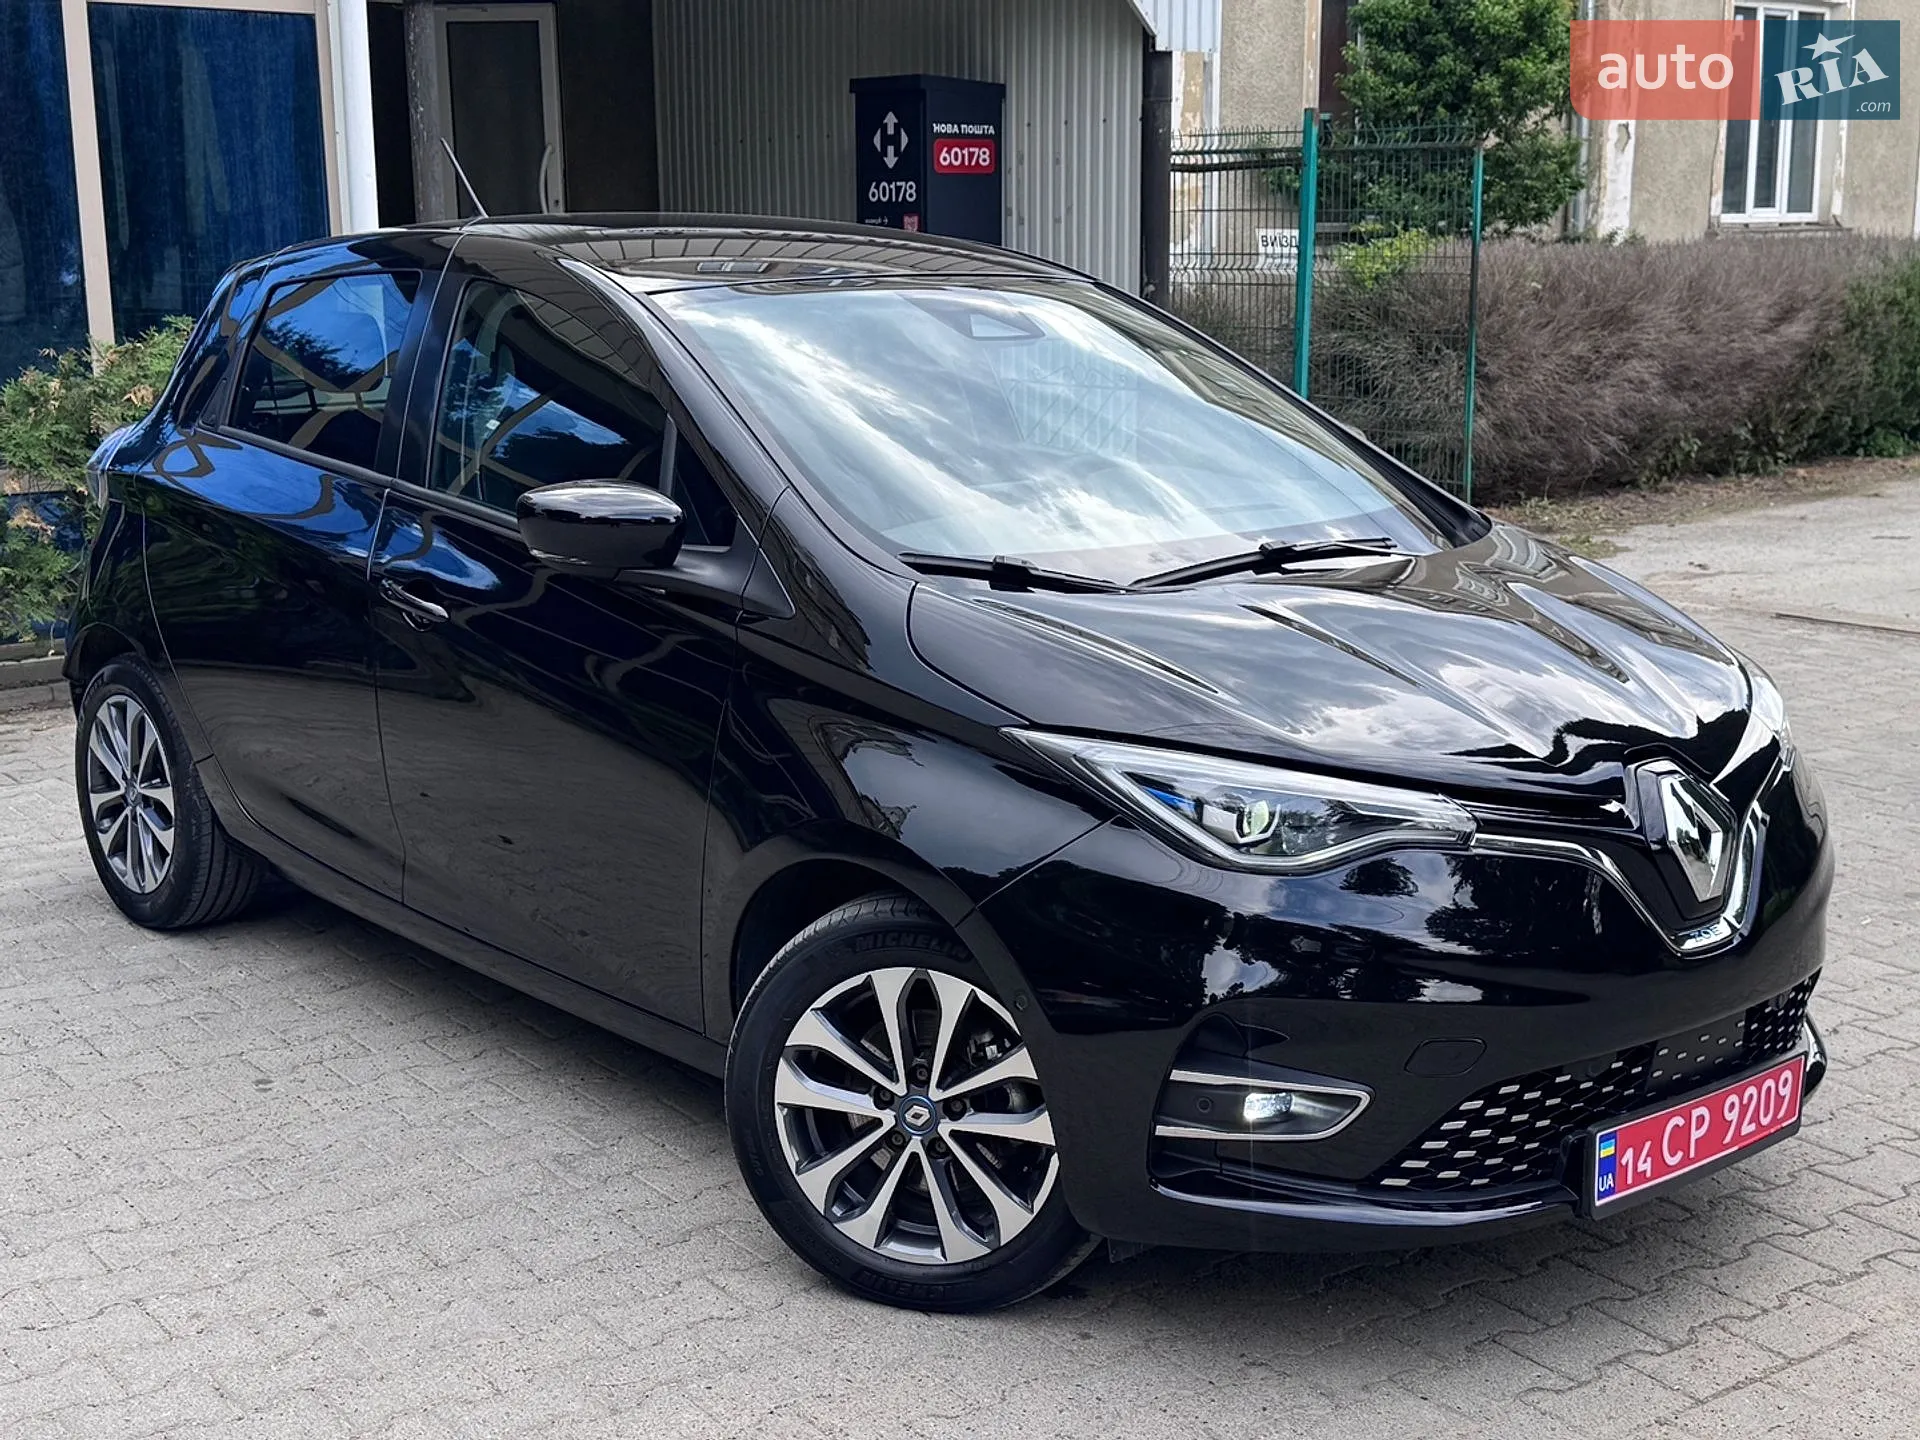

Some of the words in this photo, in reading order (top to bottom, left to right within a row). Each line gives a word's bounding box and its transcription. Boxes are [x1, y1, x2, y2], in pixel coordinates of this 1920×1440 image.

[932, 123, 959, 134] НОВА
[961, 124, 995, 136] ПОШТА
[939, 147, 990, 167] 60178
[868, 181, 917, 202] 60178
[856, 931, 969, 960] MICHELIN
[1620, 1141, 1652, 1184] 14
[1662, 1106, 1710, 1166] CP
[1723, 1070, 1793, 1144] 9209
[1599, 1174, 1614, 1192] UA
